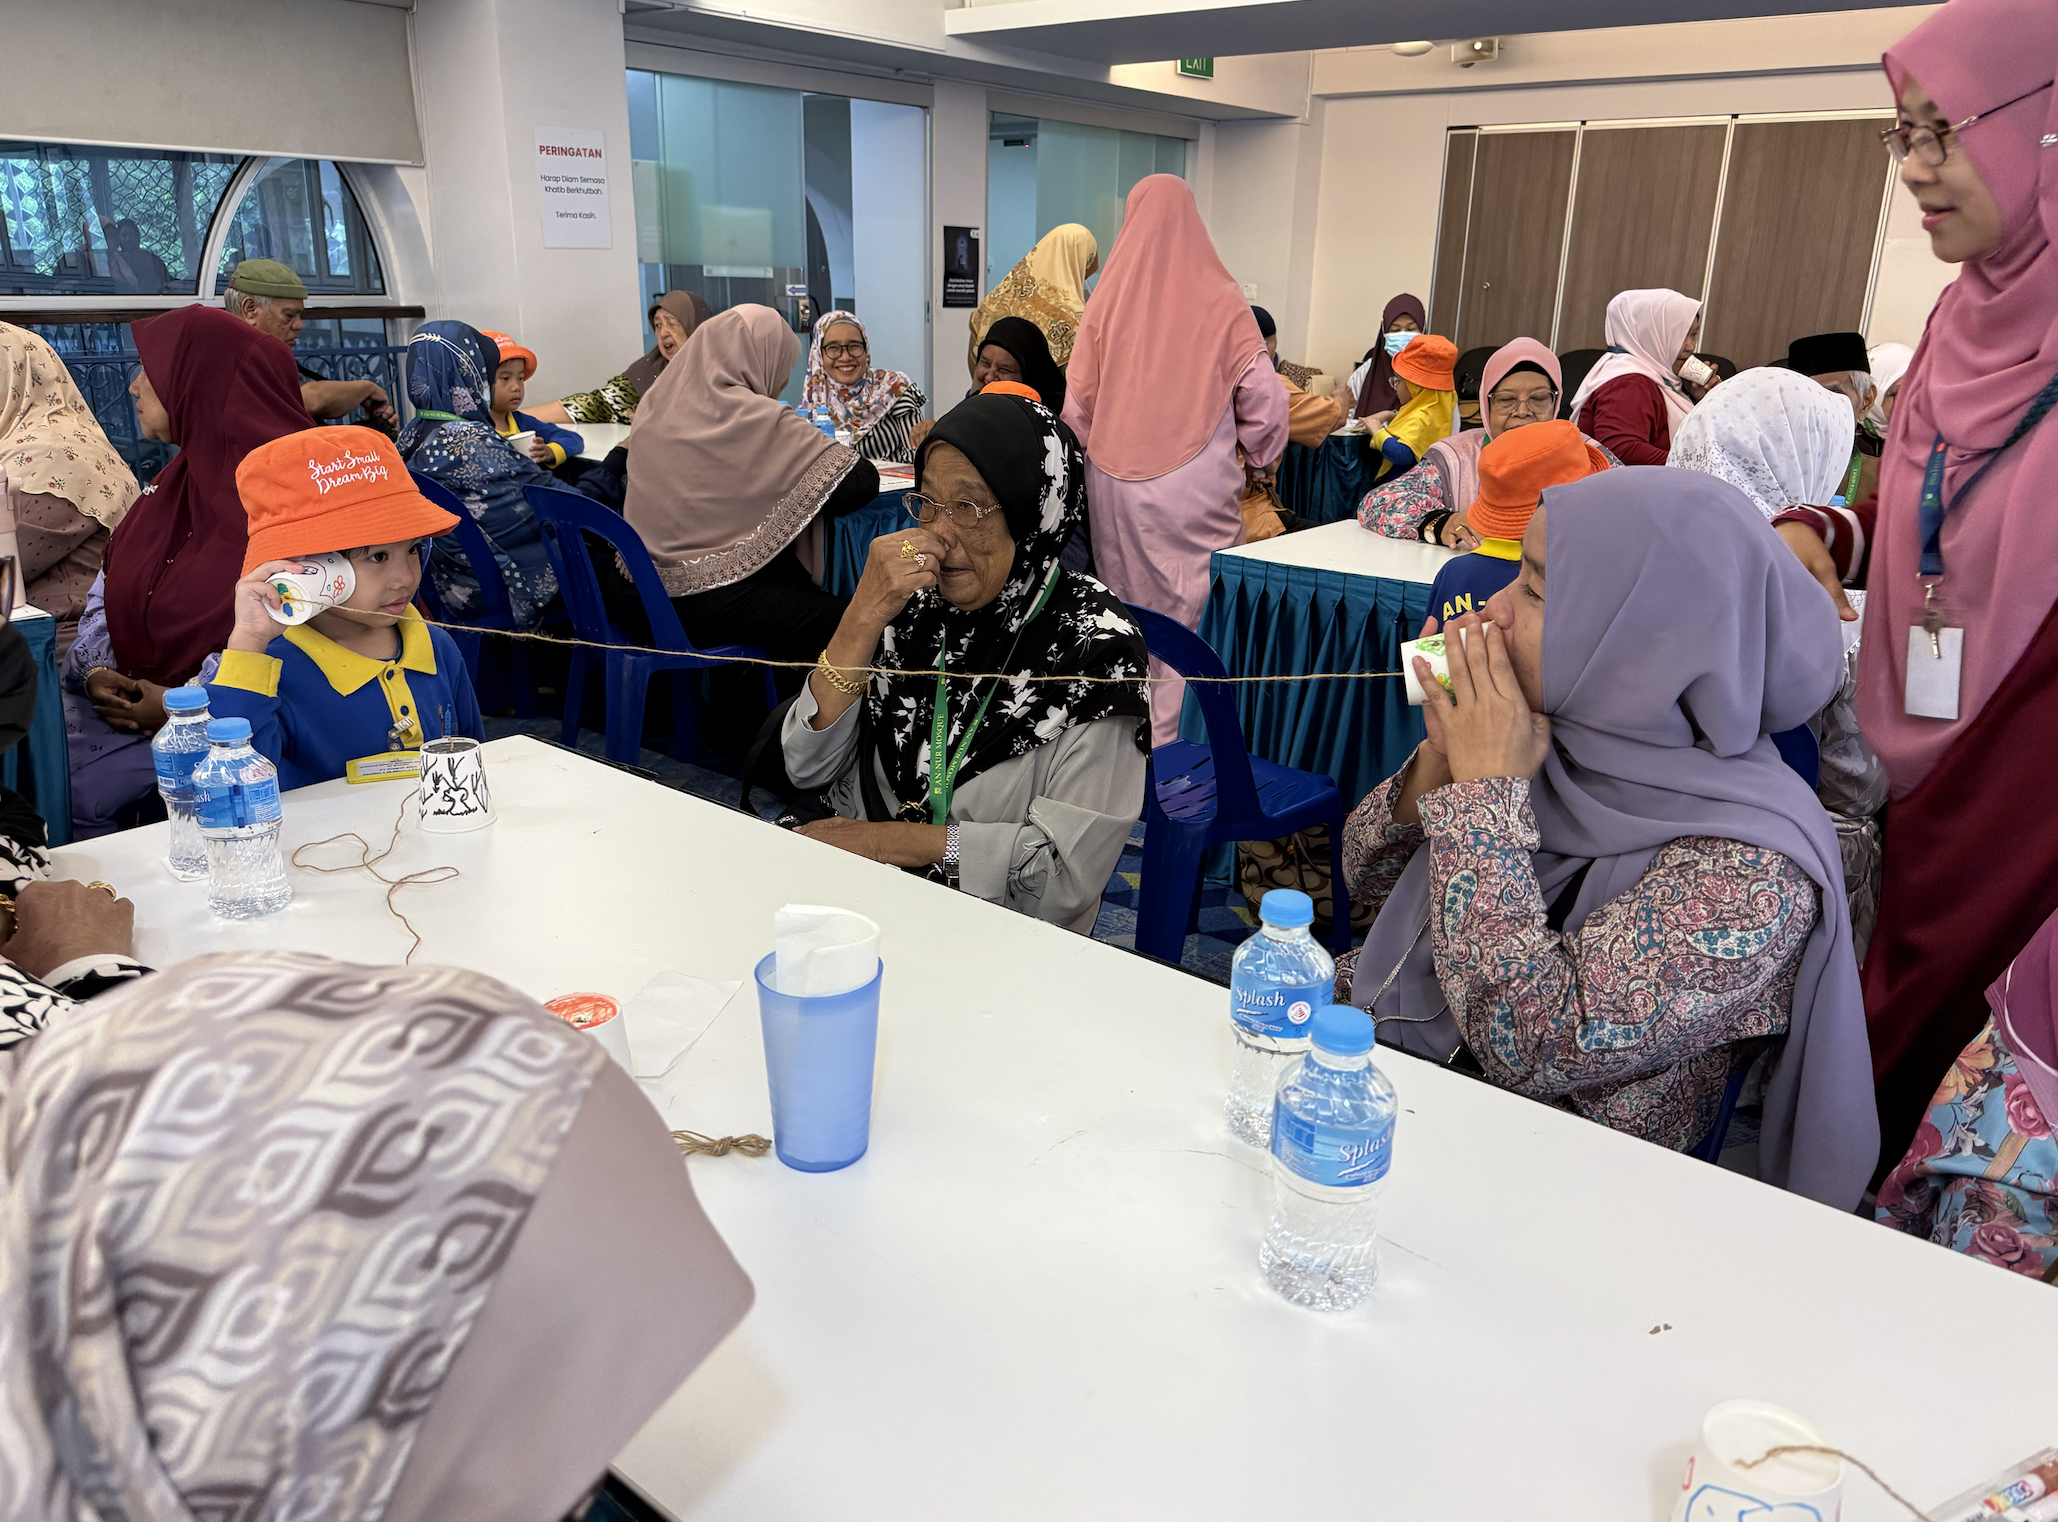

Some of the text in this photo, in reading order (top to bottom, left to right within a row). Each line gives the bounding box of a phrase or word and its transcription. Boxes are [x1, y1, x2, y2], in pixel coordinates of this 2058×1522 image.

[539, 145, 602, 159] PERINGATAN
[540, 174, 606, 185] Harap Diam Semasa
[544, 185, 603, 195] Khatib Berkhutbah.
[556, 211, 578, 219] Terima
[308, 449, 380, 479] Start Small
[316, 465, 388, 494] Dream Big
[935, 713, 944, 785] AN-NUR MOSQUE
[1236, 986, 1286, 1008] Splash
